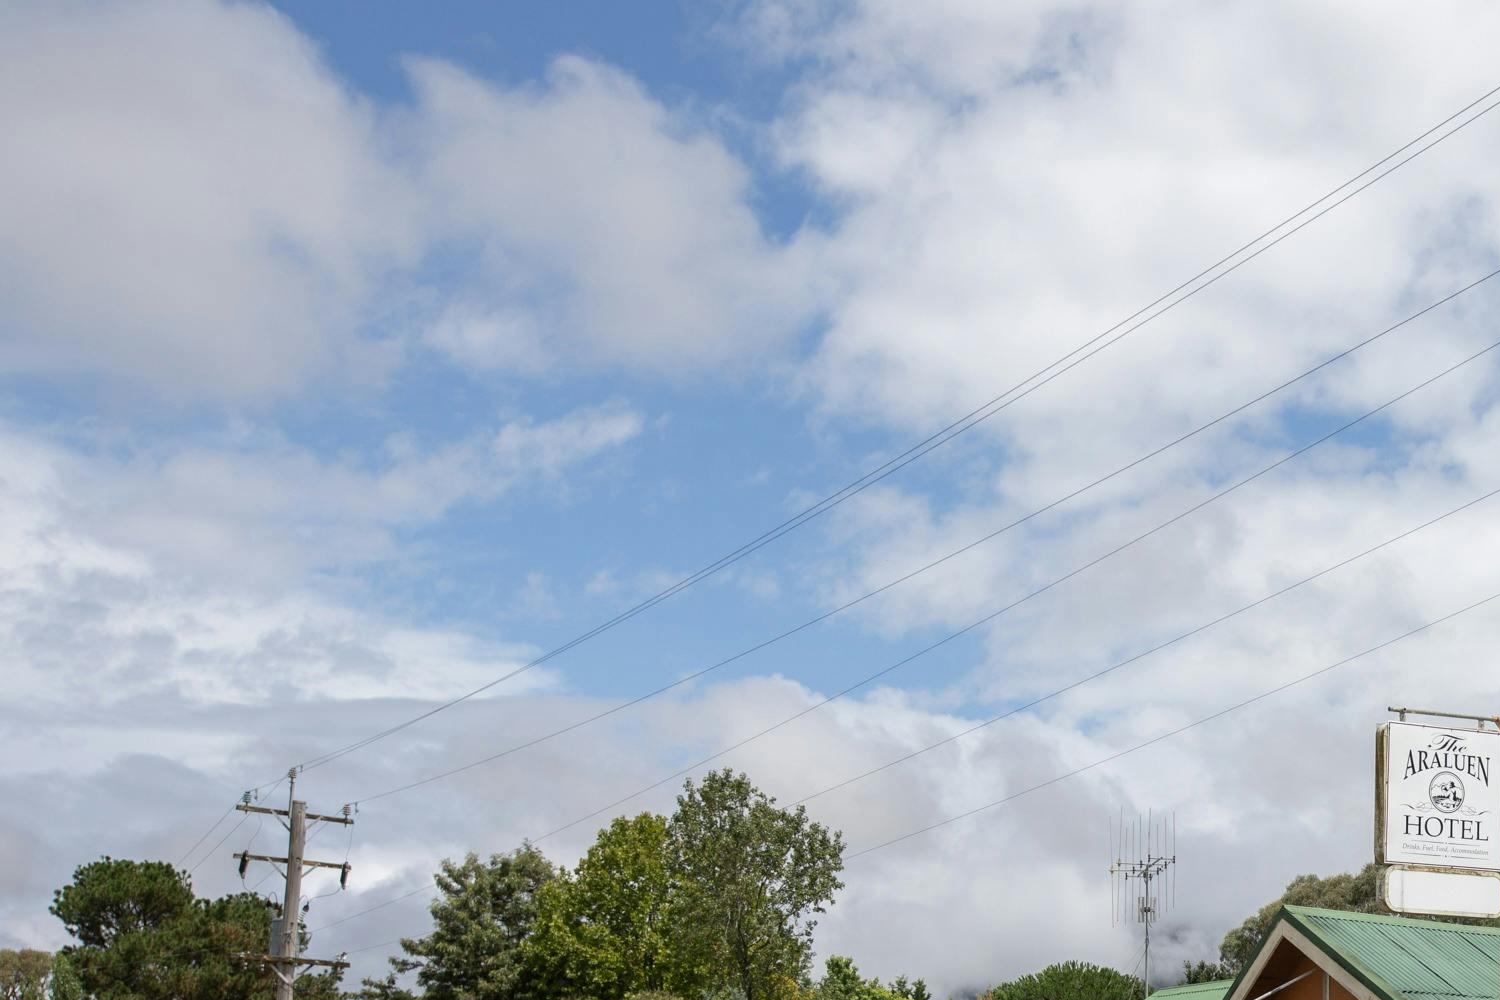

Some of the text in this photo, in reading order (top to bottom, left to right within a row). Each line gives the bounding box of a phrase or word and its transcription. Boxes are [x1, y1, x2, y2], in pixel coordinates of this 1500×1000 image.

[1428, 733, 1467, 753] The
[1403, 749, 1490, 787] ARALUEN
[1403, 815, 1489, 842] HOTEL
